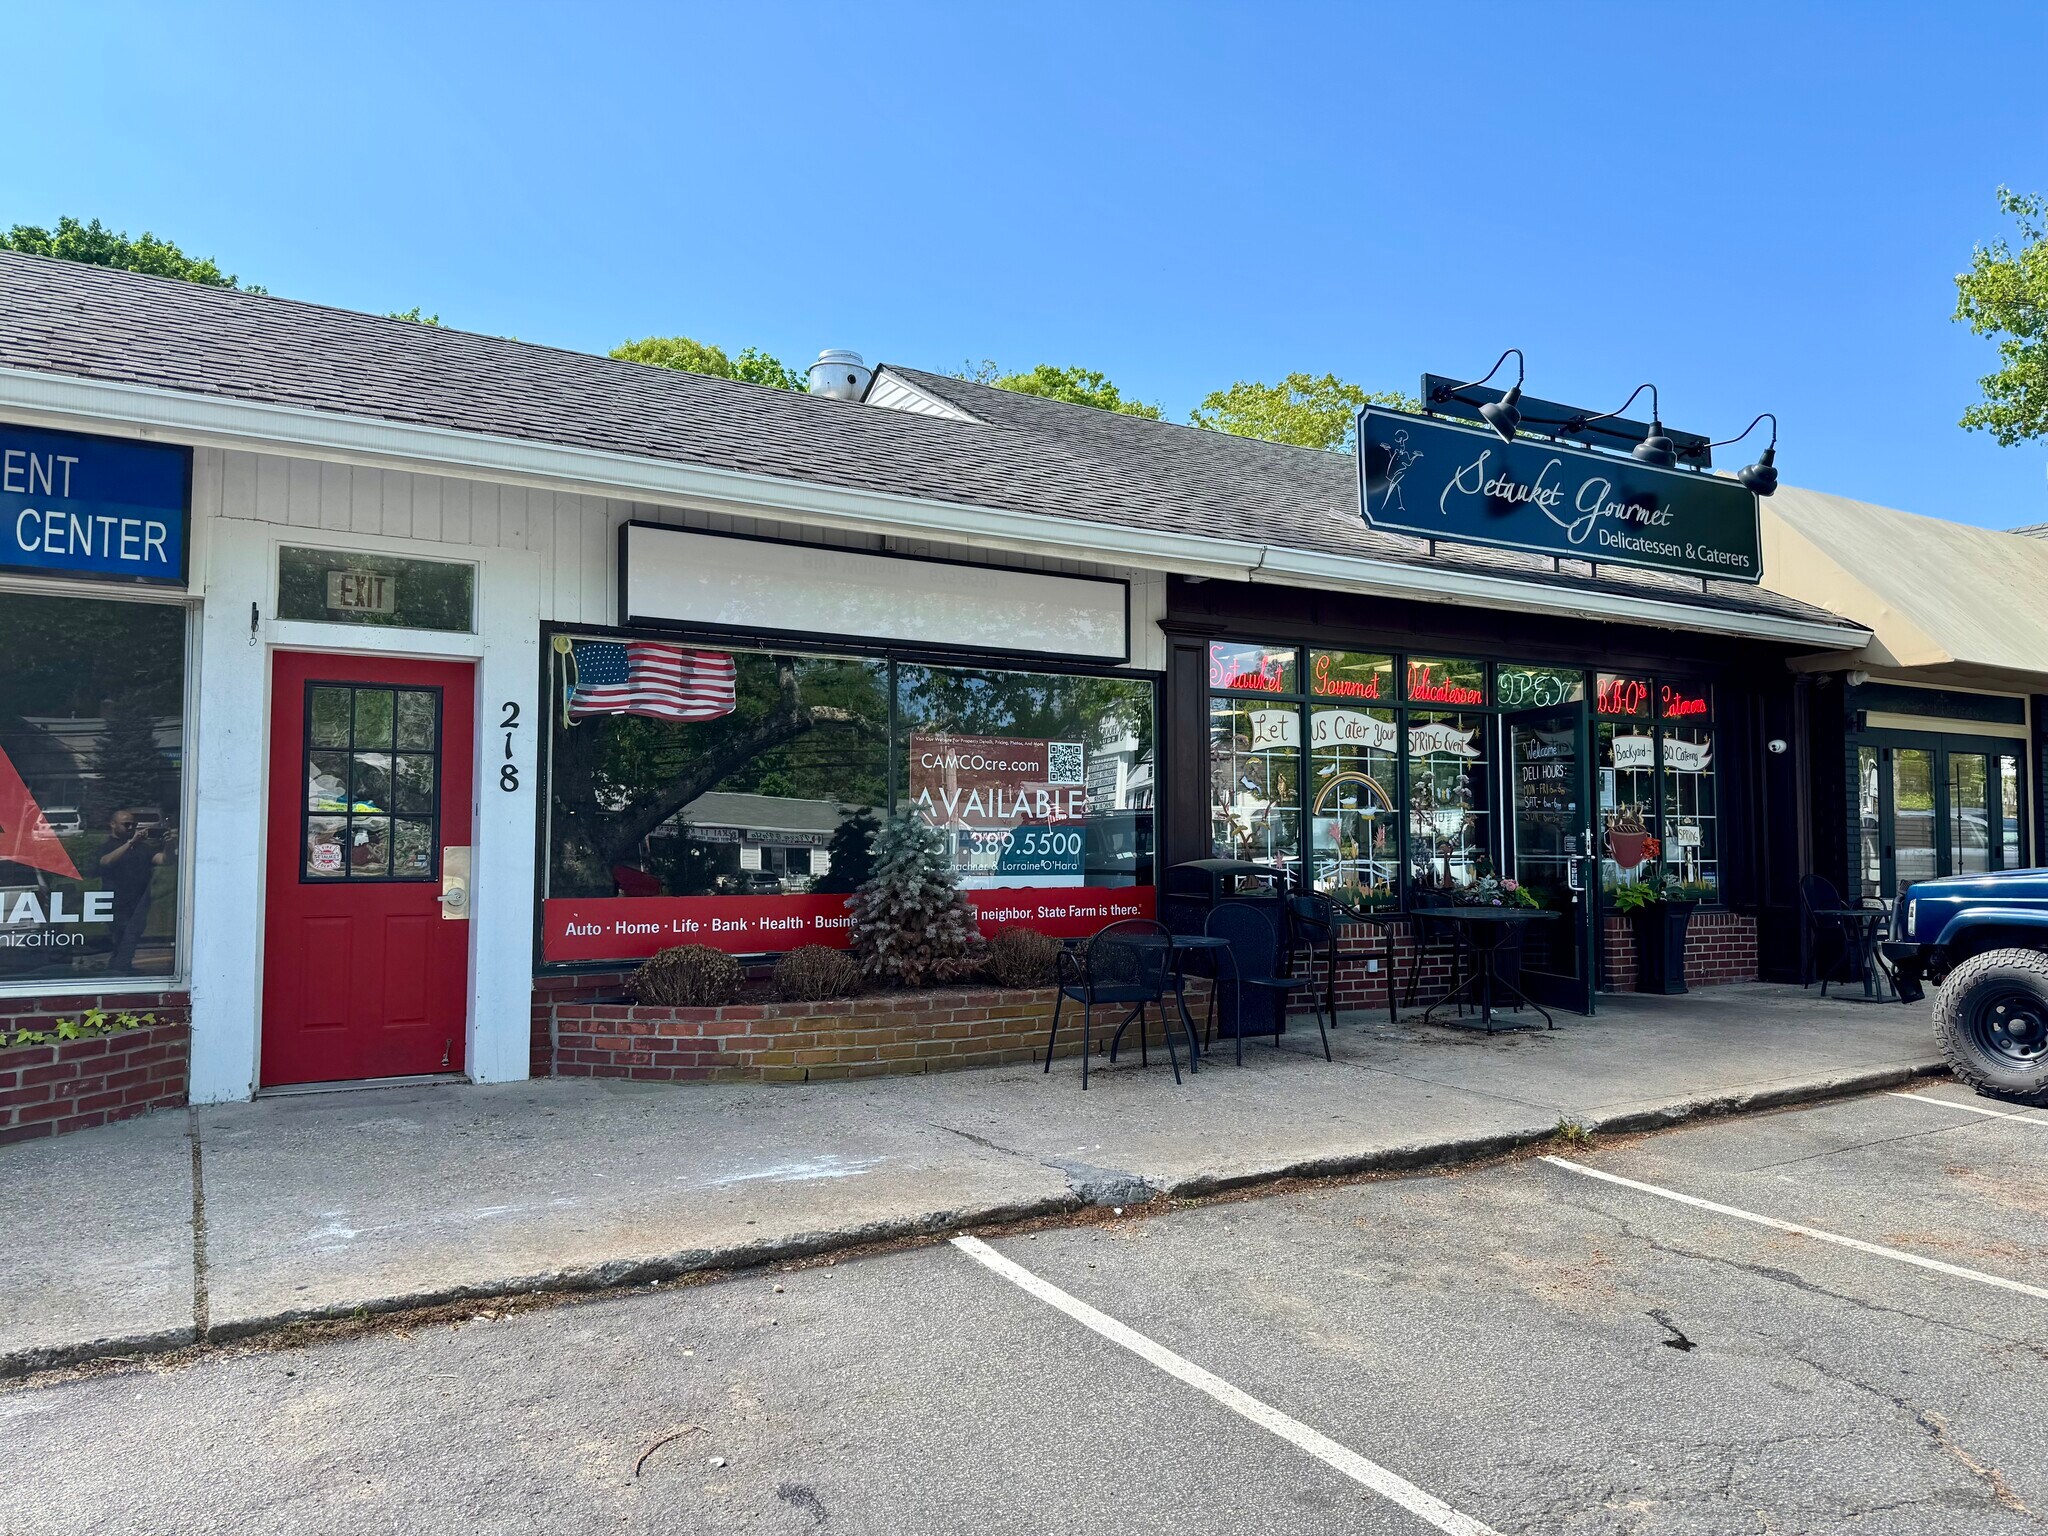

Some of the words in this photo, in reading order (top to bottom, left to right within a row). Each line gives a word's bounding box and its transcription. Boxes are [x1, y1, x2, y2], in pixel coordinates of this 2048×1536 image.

[3, 449, 79, 498] ENT
[1440, 449, 1568, 526] Setauket
[1567, 477, 1674, 544] Gourmet
[16, 508, 168, 563] CENTER
[1599, 528, 1682, 558] Delicatessen
[1685, 542, 1696, 559] &
[1697, 545, 1750, 568] Caterers
[340, 574, 386, 609] EXIT
[1210, 645, 1284, 693] Setauket
[1314, 655, 1380, 699] Gourmet
[1407, 661, 1483, 705] Delicatessen
[499, 701, 521, 793] 218
[1254, 713, 1289, 744] Let
[1334, 715, 1370, 741] Cater
[1373, 723, 1396, 748] Your
[1444, 731, 1467, 754] Event
[1522, 738, 1558, 760] Welcome
[921, 753, 1040, 773] CAMCOcre.com
[1522, 765, 1539, 782] DELI
[1542, 764, 1568, 779] HOURS:
[913, 786, 1083, 819] AVAILABLE
[930, 832, 1082, 855] 1.389.5500
[1002, 861, 1040, 871] Lorraine
[0, 891, 115, 924] ALE
[981, 907, 1034, 922] neighbor,
[1037, 905, 1066, 918] State
[1069, 904, 1096, 917] Farm
[1099, 904, 1108, 916] is
[565, 922, 602, 936] Auto
[615, 920, 660, 935] Home
[672, 918, 700, 933] Life
[711, 917, 748, 932] Bank
[759, 916, 804, 930] Health
[814, 914, 859, 929] Busine
